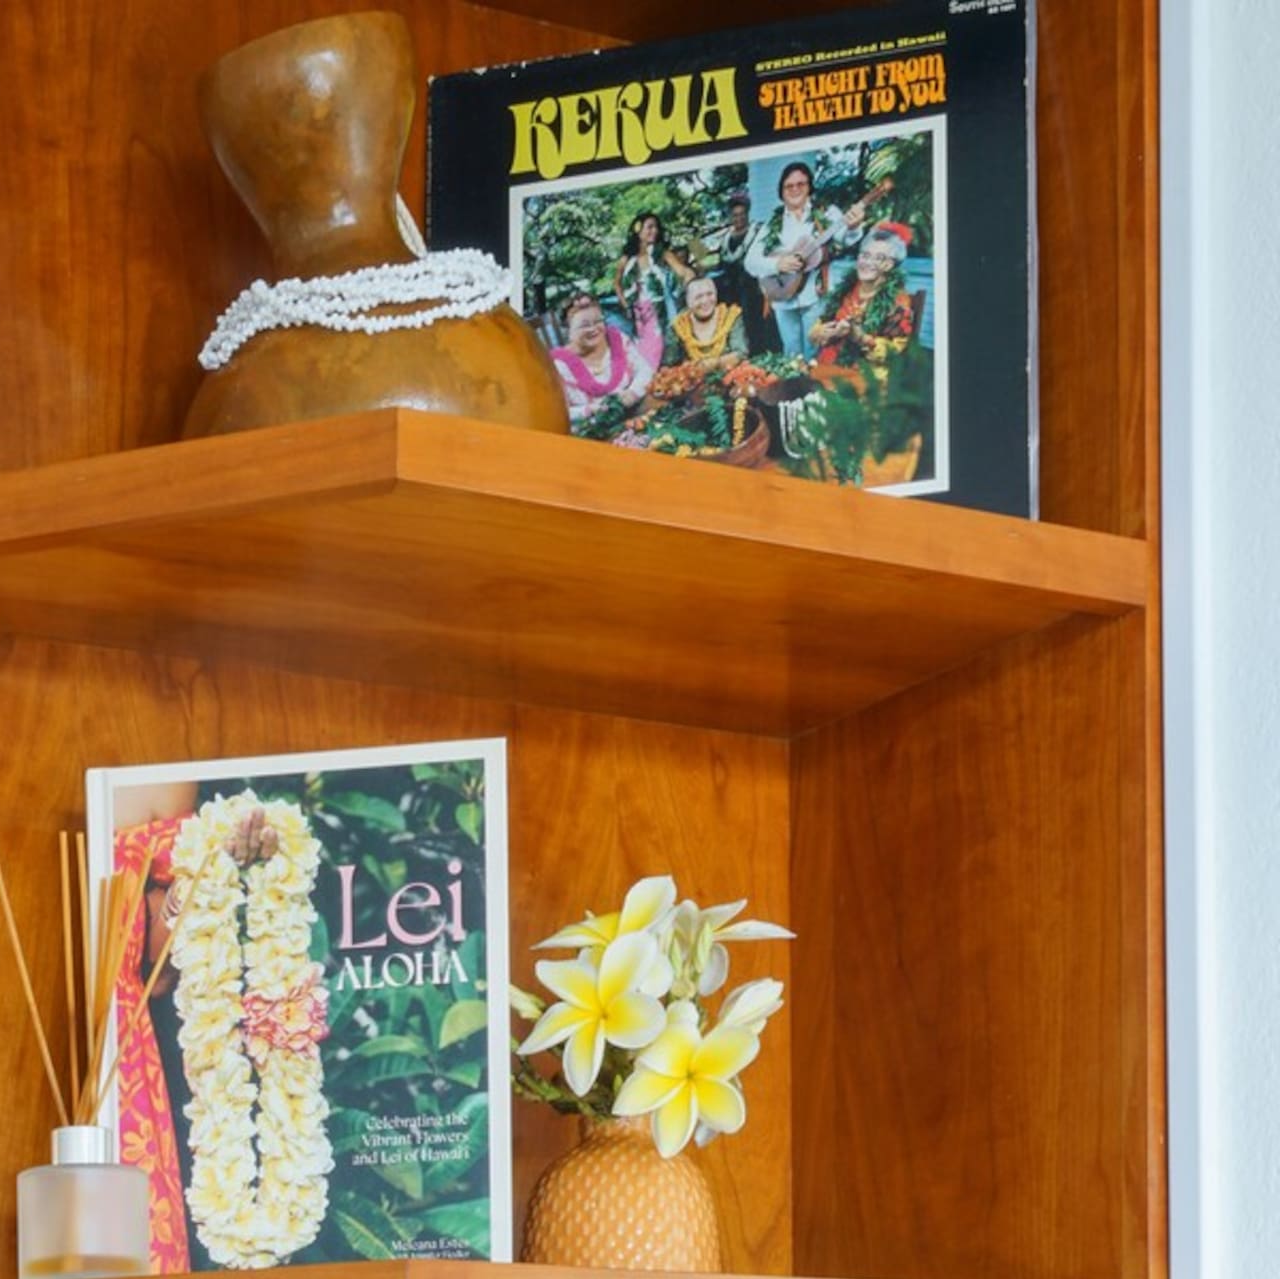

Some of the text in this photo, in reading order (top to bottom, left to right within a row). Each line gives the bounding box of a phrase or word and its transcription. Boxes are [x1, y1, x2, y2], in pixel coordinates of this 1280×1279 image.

[755, 31, 947, 72] STEREO Recorded in Hawaii
[759, 53, 946, 108] STRAIGHT FROM
[508, 67, 748, 180] KEKUA
[773, 92, 864, 130] HAWAII
[867, 87, 896, 114] TO
[337, 858, 466, 949] Lei
[336, 949, 468, 991] ALOHA
[362, 1131, 469, 1147] Vibrant Flowers
[366, 1112, 468, 1131] Celebrating the
[352, 1151, 378, 1166] and
[381, 1151, 402, 1164] Lei
[404, 1150, 419, 1162] of
